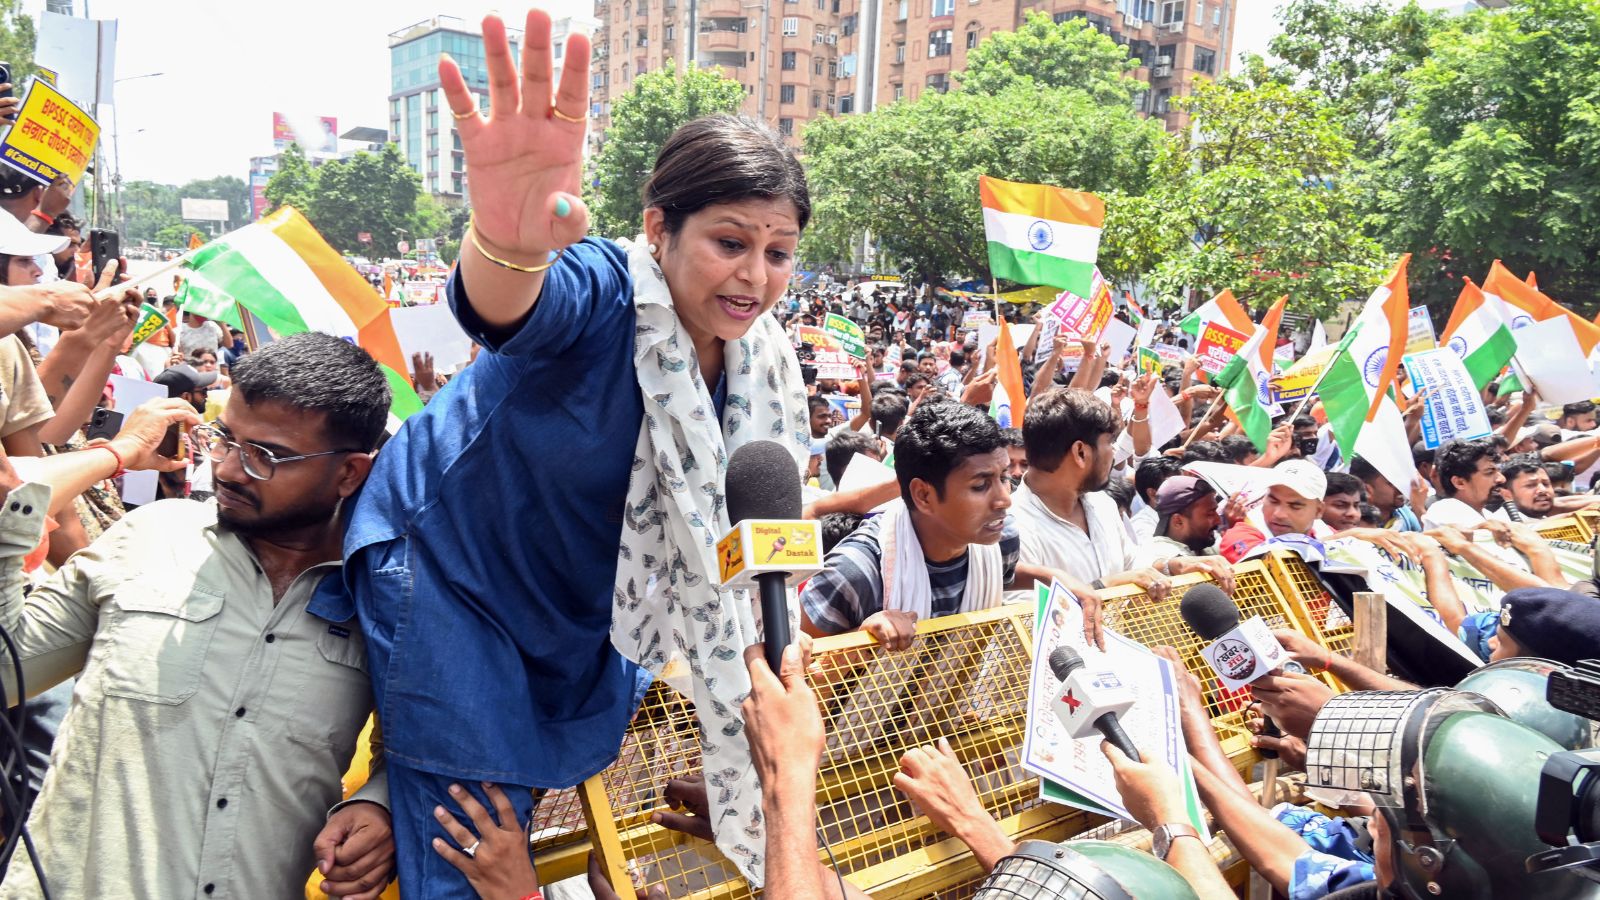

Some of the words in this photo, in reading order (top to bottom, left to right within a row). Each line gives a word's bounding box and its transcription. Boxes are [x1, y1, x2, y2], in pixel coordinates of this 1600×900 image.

[42, 98, 69, 126] BPSSC
[5, 148, 38, 170] #Cancel
[1204, 327, 1230, 347] BSSC
[756, 527, 781, 535] Digital
[786, 549, 814, 557] Dastak
[1219, 645, 1240, 663] खबर
